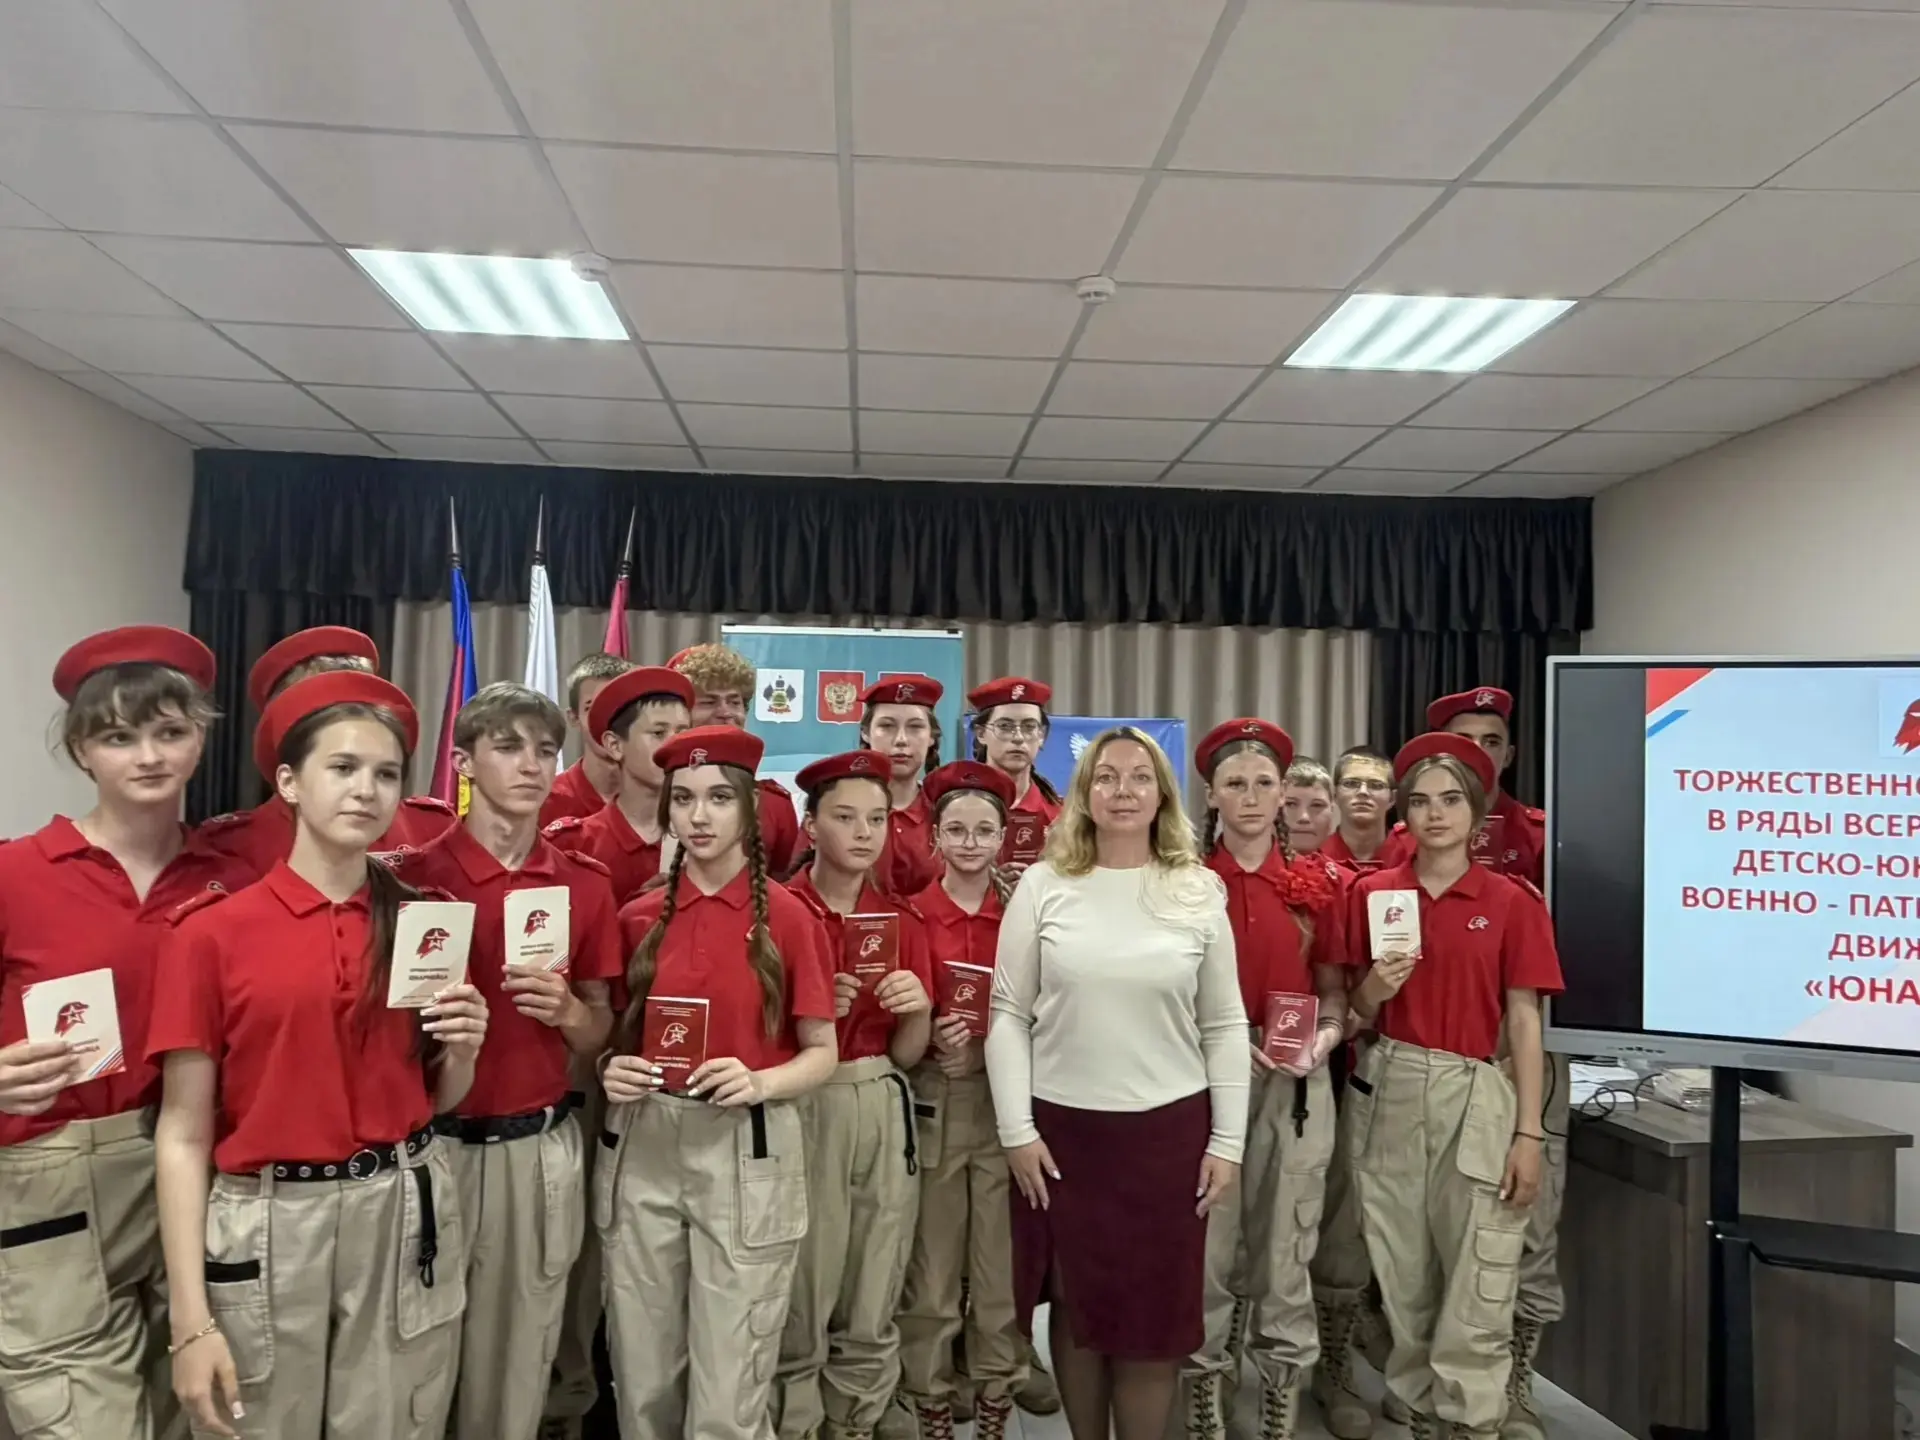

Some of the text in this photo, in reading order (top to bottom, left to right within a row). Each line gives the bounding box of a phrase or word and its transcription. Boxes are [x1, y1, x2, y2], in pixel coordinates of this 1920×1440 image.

[1673, 769, 1920, 796] ТОРЖЕСТВЕНН
[1708, 809, 1920, 838] В РЯДЫ ВСЕР
[1682, 886, 1818, 914] ВОЕННО
[1850, 894, 1920, 919] ПАТ
[1804, 974, 1920, 1006] «ЮНА
